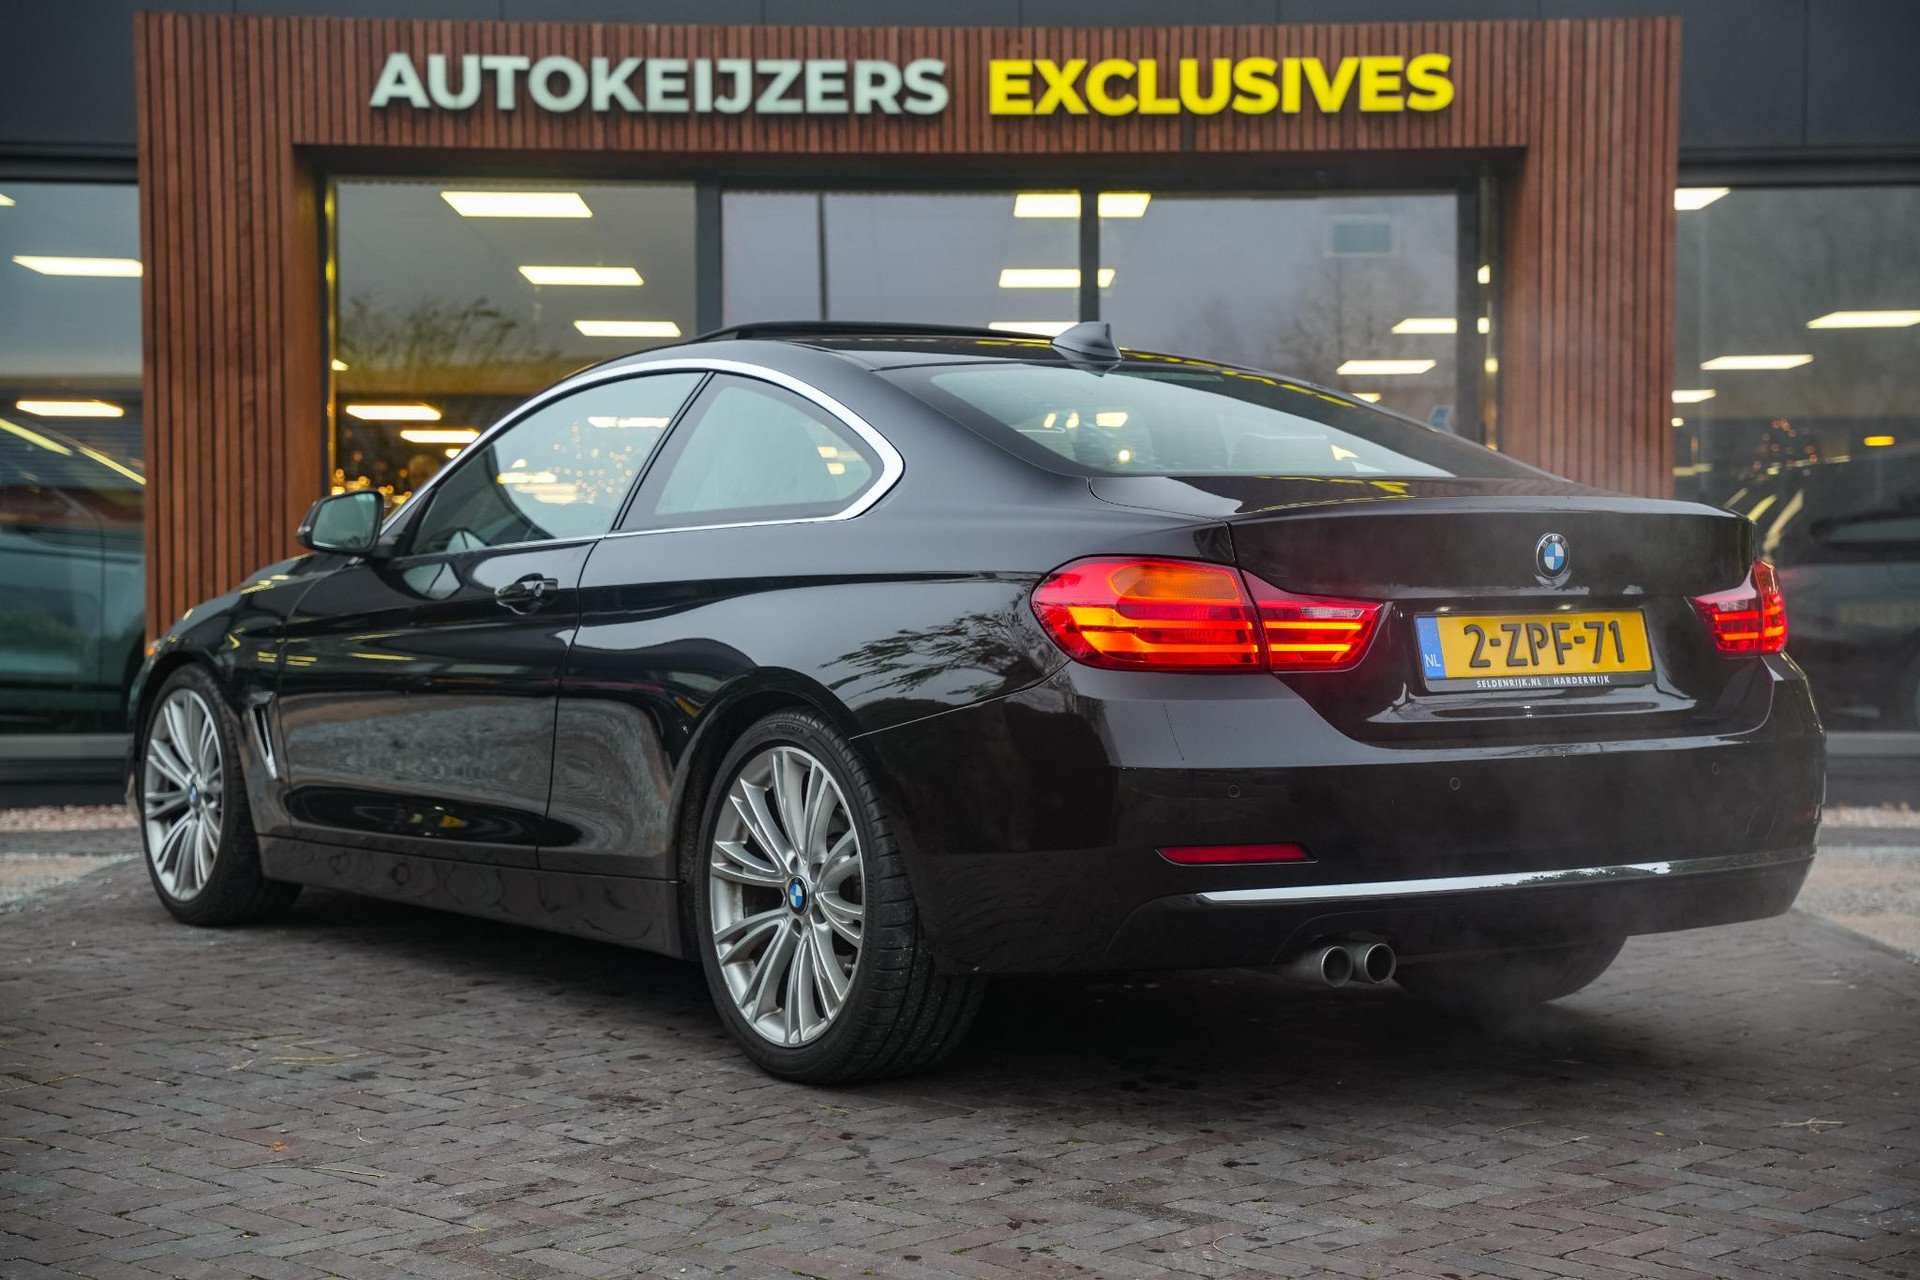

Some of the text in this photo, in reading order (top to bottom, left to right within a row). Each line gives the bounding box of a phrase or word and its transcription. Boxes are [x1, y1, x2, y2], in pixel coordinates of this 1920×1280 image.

[369, 53, 1455, 117] AUTOKEIJZERS EXCLUSIVES
[1463, 620, 1625, 668] 2-ZPF-71
[1424, 653, 1442, 668] NL
[1476, 675, 1610, 689] SELDENRIJK.NL HARDERWIJK
